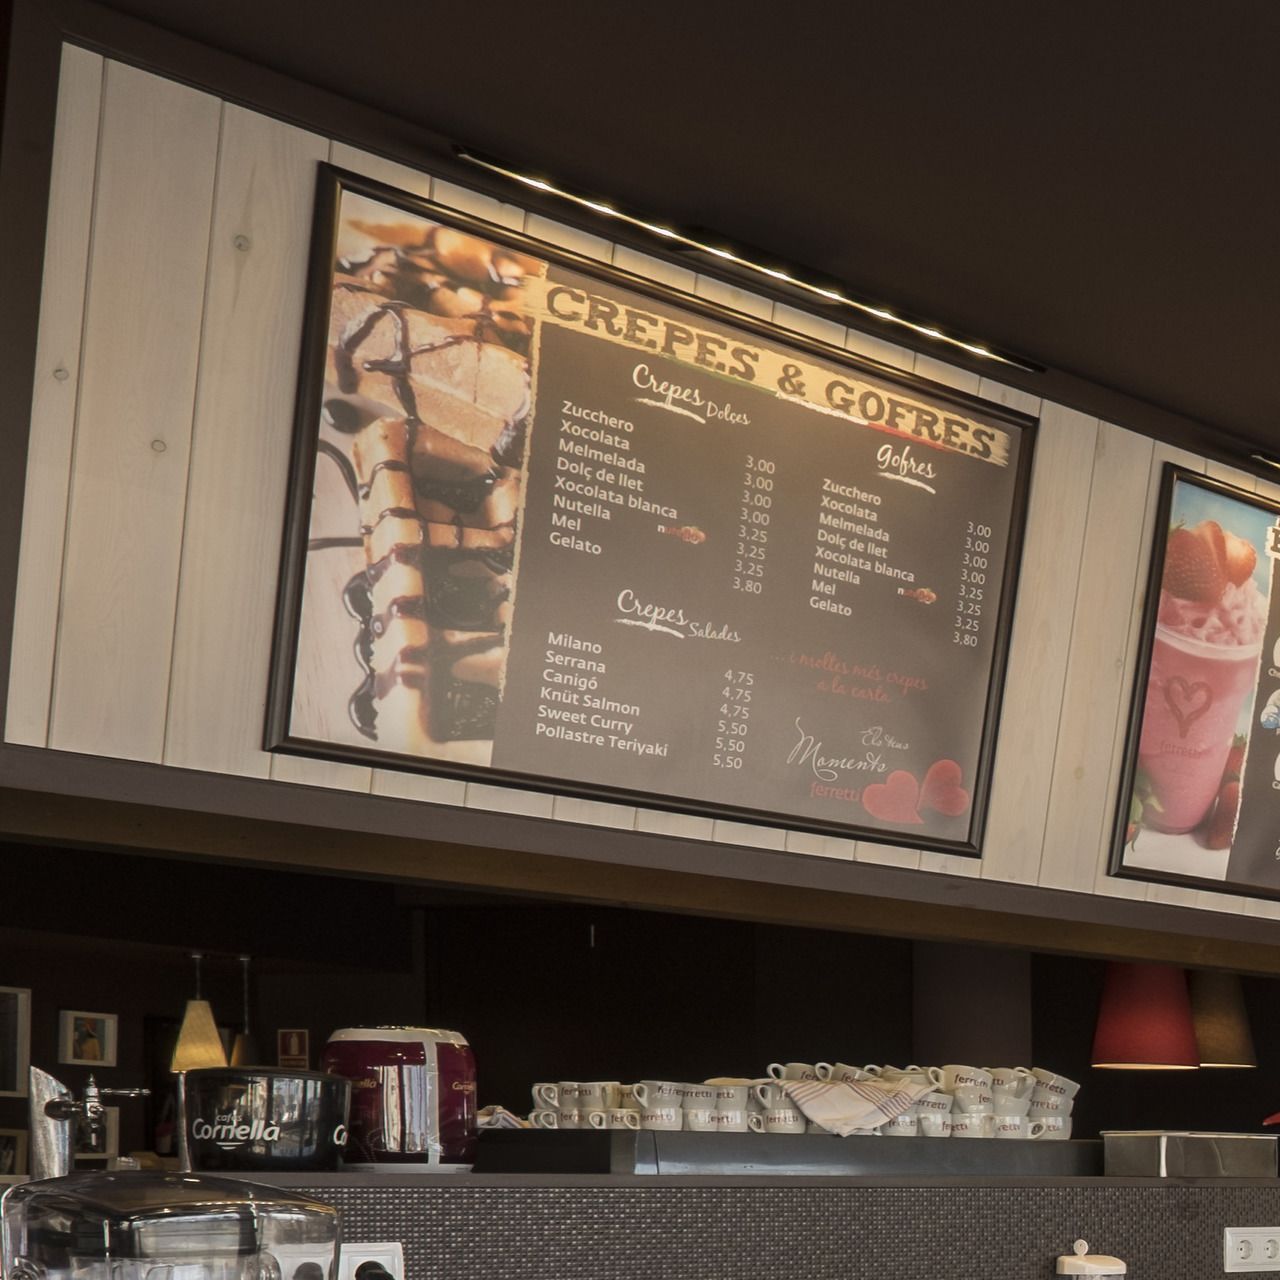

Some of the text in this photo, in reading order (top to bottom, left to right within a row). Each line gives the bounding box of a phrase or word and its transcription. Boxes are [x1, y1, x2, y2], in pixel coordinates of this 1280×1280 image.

[547, 283, 995, 460] CREPES & GOFRES
[632, 363, 704, 405] Crepes
[561, 400, 633, 432] Zucchero
[560, 419, 629, 449] Xocolata
[559, 438, 644, 473] Melmelada
[745, 455, 775, 474] 3,00
[557, 456, 642, 491] Dolç de llet
[743, 472, 773, 491] 3,00
[554, 475, 677, 519] Xocolata blanca
[742, 489, 771, 508] 3,00
[822, 478, 881, 505] Zucchero
[553, 494, 610, 519] Nutella
[740, 507, 769, 525] 3,00
[820, 495, 877, 521] Xocolata
[551, 512, 580, 530] Mel
[819, 512, 888, 541] Melmelada
[549, 531, 601, 554] Gelato
[738, 524, 767, 542] 3,25
[817, 529, 886, 558] Dolç de llet
[736, 542, 765, 559] 3,25
[735, 559, 763, 576] 3,25
[813, 562, 859, 584] Nutella
[815, 546, 914, 581] Xocolata blanca
[733, 576, 761, 594] 3,80
[812, 579, 835, 594] Mel
[617, 589, 688, 629] Crepes
[809, 596, 851, 615] Gelato
[548, 631, 601, 653] Milano
[545, 650, 605, 673] Serrana
[542, 668, 597, 690] Canigó
[724, 669, 753, 685] 4,75
[540, 686, 639, 715] Knüt Salmon
[722, 686, 751, 702] 4,75
[537, 704, 632, 735] Sweet Curry
[719, 703, 748, 719] 4,75
[717, 719, 747, 735] 5,50
[535, 722, 667, 756] Pollastre Teriyaki
[715, 736, 744, 752] 5,50
[713, 753, 742, 769] 5,50
[192, 1118, 281, 1141] Cornellà
